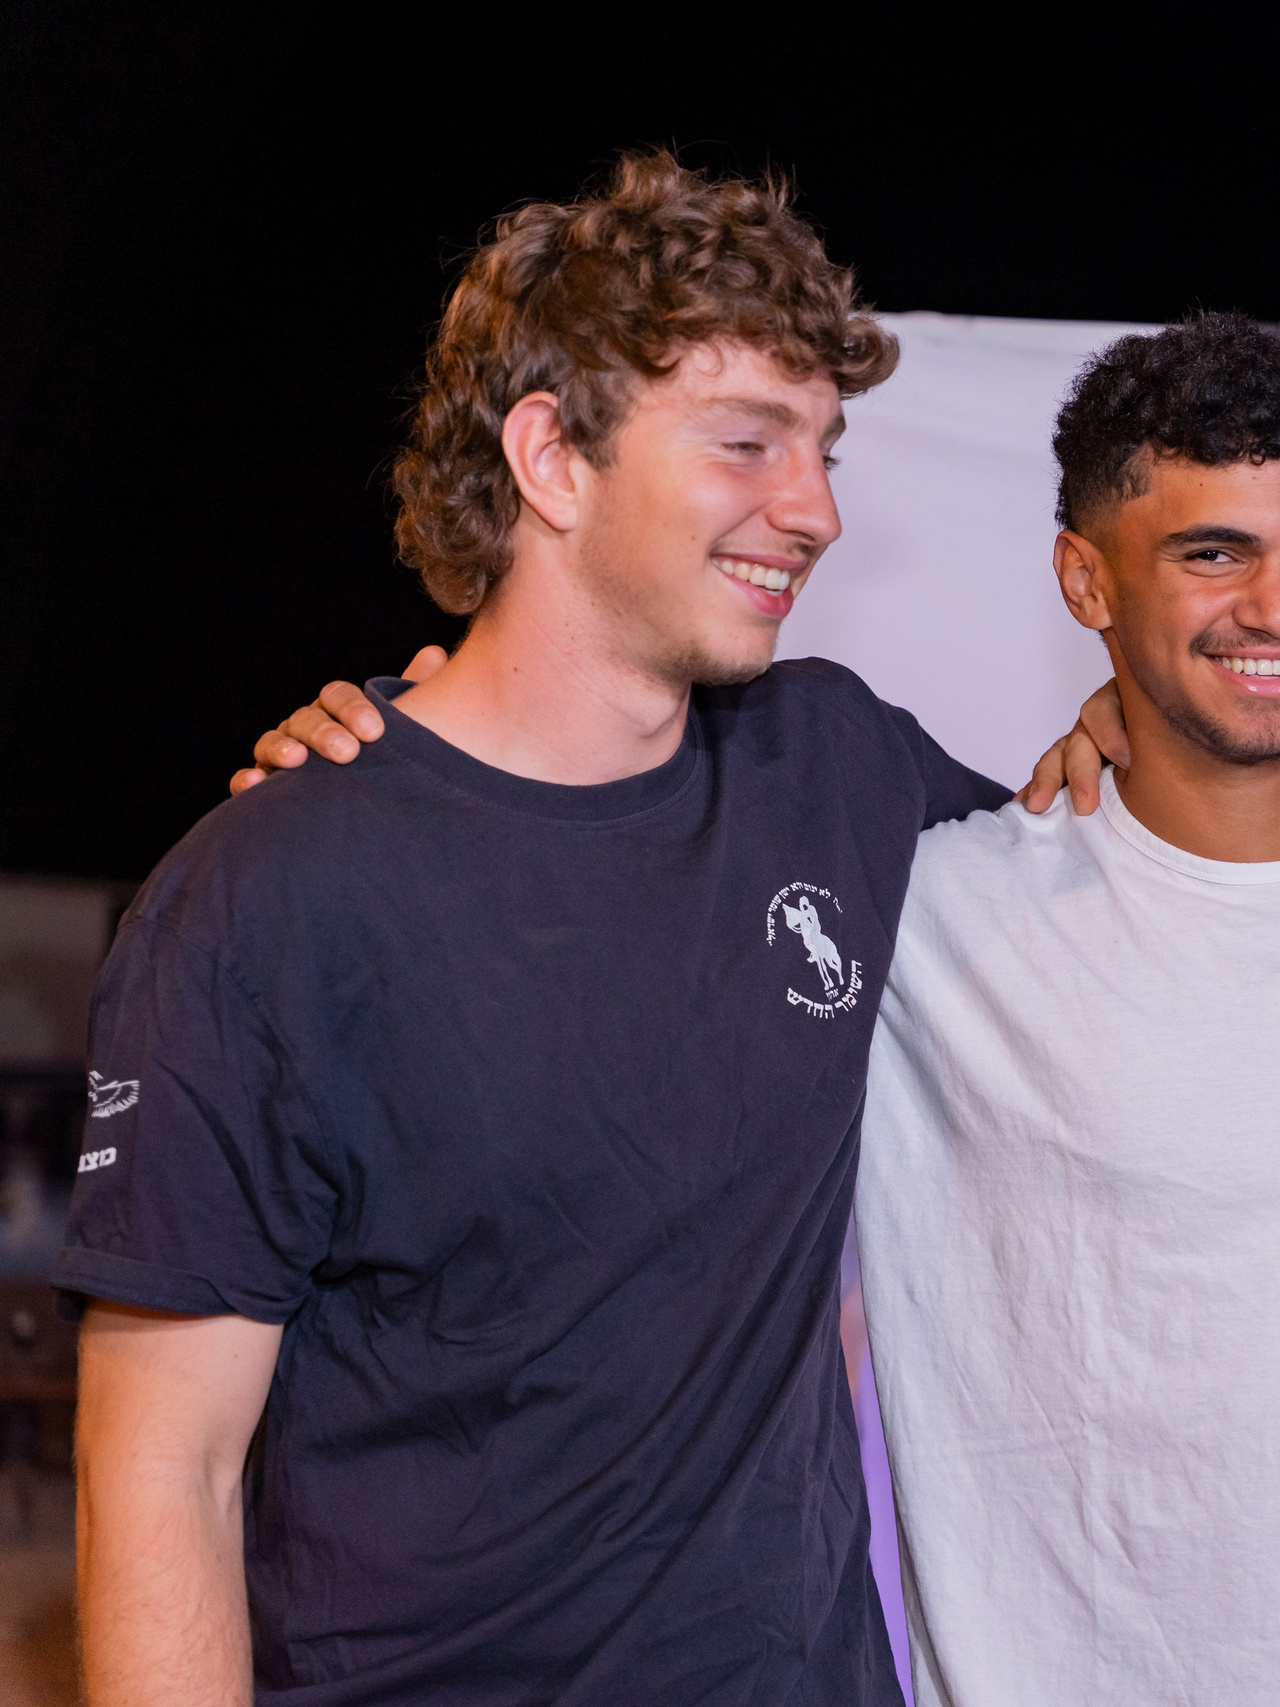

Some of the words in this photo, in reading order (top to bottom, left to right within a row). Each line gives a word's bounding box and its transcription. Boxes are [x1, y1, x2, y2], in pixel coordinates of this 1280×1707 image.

[778, 886, 790, 900] ישן
[818, 888, 831, 899] לא
[834, 959, 863, 1012] השומר
[786, 987, 835, 1020] החדש
